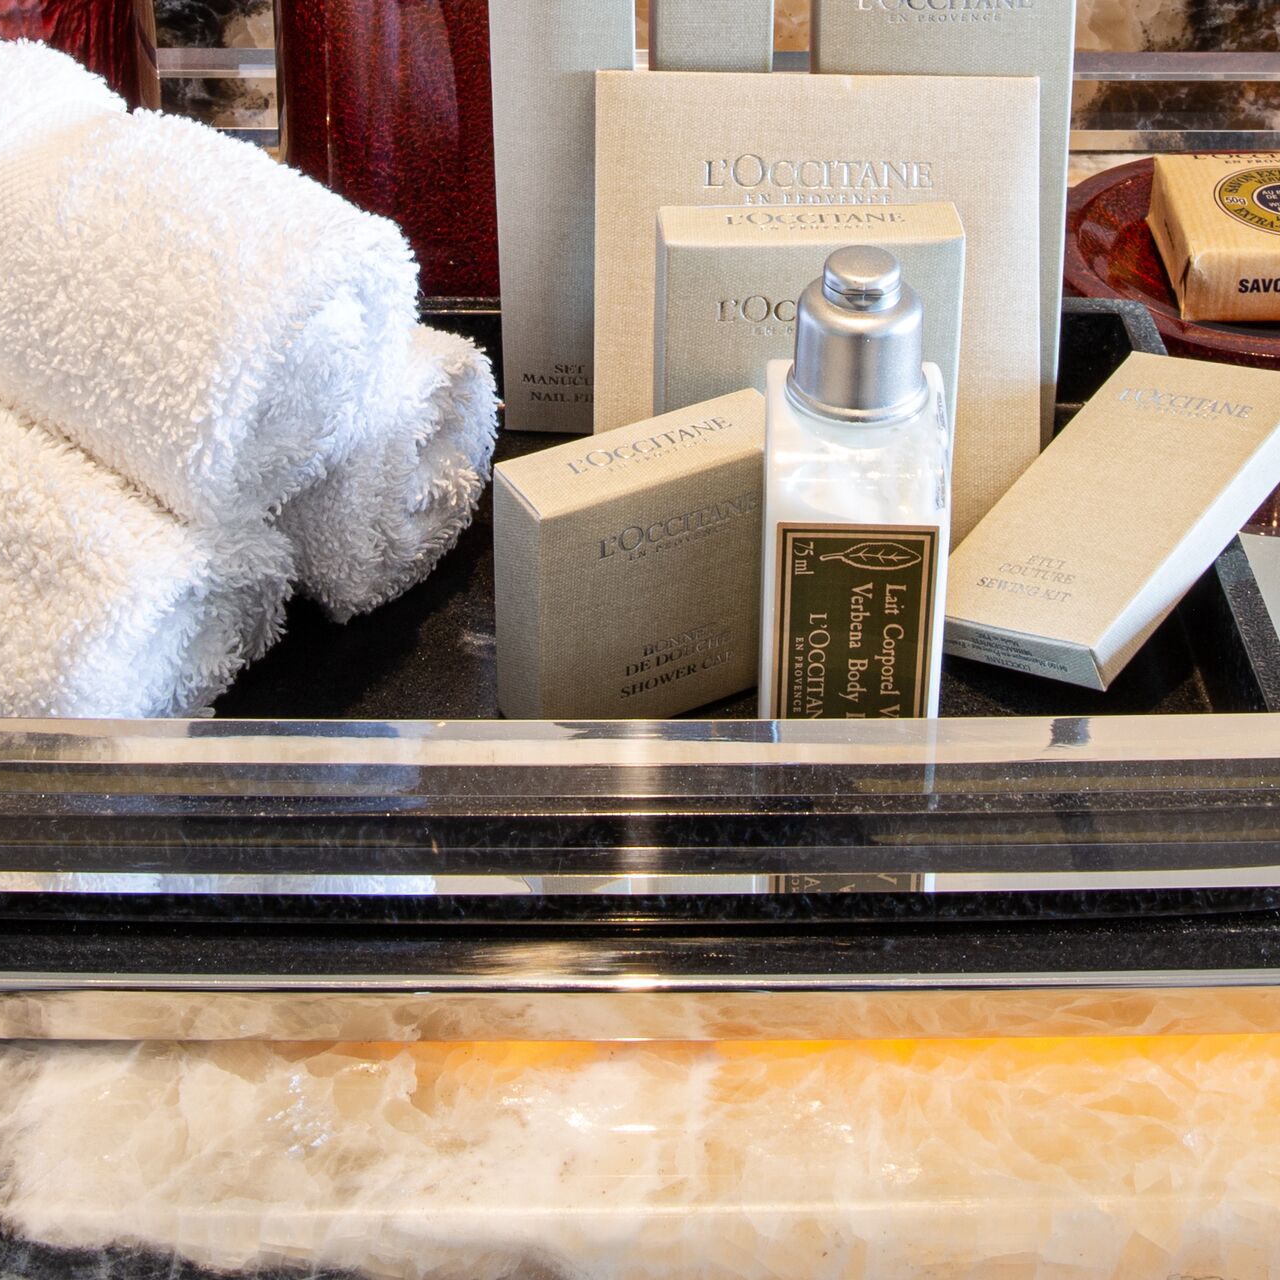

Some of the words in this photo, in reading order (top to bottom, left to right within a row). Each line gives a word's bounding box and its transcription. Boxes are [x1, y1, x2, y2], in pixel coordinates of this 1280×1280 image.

[888, 13, 907, 23] EN
[917, 12, 1002, 23] PROVENCE
[703, 153, 935, 189] L'OCCITANE
[745, 193, 771, 204] EN
[783, 193, 891, 204] PROVENCE
[1224, 195, 1248, 206] 50g
[726, 211, 906, 225] L'OCCITANE
[554, 364, 586, 375] SET
[530, 391, 570, 402] NAIL
[567, 416, 733, 475] L'OCCITANE
[598, 491, 760, 560] L'OCCITANE
[794, 541, 816, 557] 75
[794, 559, 815, 576] ml
[999, 563, 1076, 585] COUTURE
[884, 583, 907, 616] Lait
[976, 576, 1041, 597] SEWING
[1040, 589, 1072, 603] KIT
[849, 582, 874, 650] Verbena
[795, 636, 805, 651] EN
[625, 659, 652, 676] DE
[874, 623, 905, 696] Corporel
[620, 663, 698, 699] SHOWER
[792, 656, 804, 713] PROVENCE
[838, 658, 869, 703] Body
